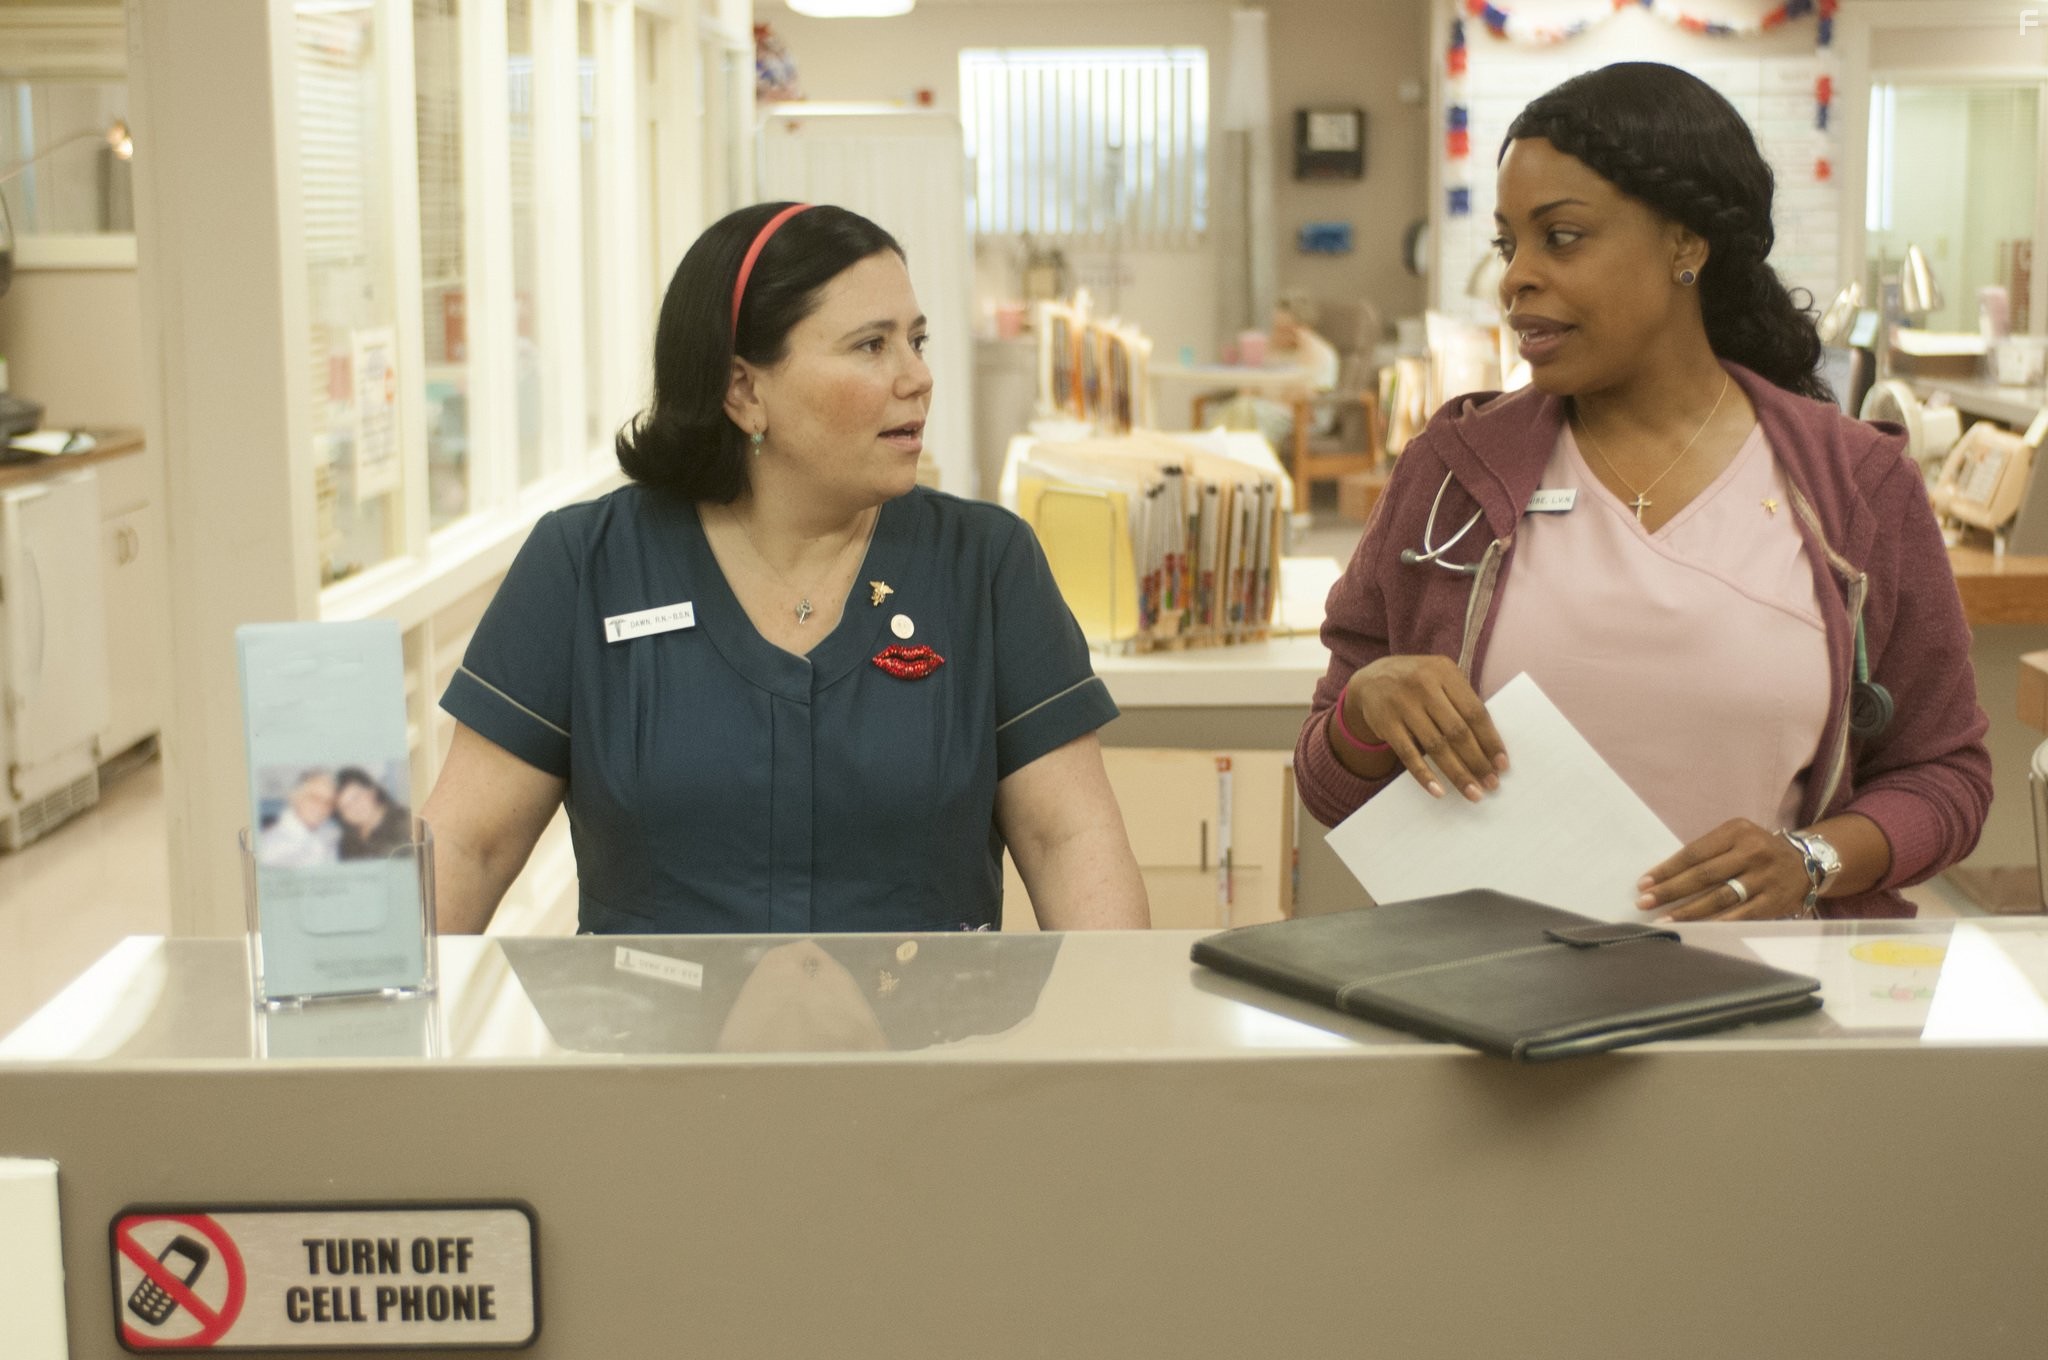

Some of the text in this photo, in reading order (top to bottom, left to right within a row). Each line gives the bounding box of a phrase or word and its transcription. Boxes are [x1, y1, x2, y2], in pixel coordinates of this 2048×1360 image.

[302, 1236, 474, 1275] TURN OFF
[285, 1283, 497, 1323] CELL PHONE
